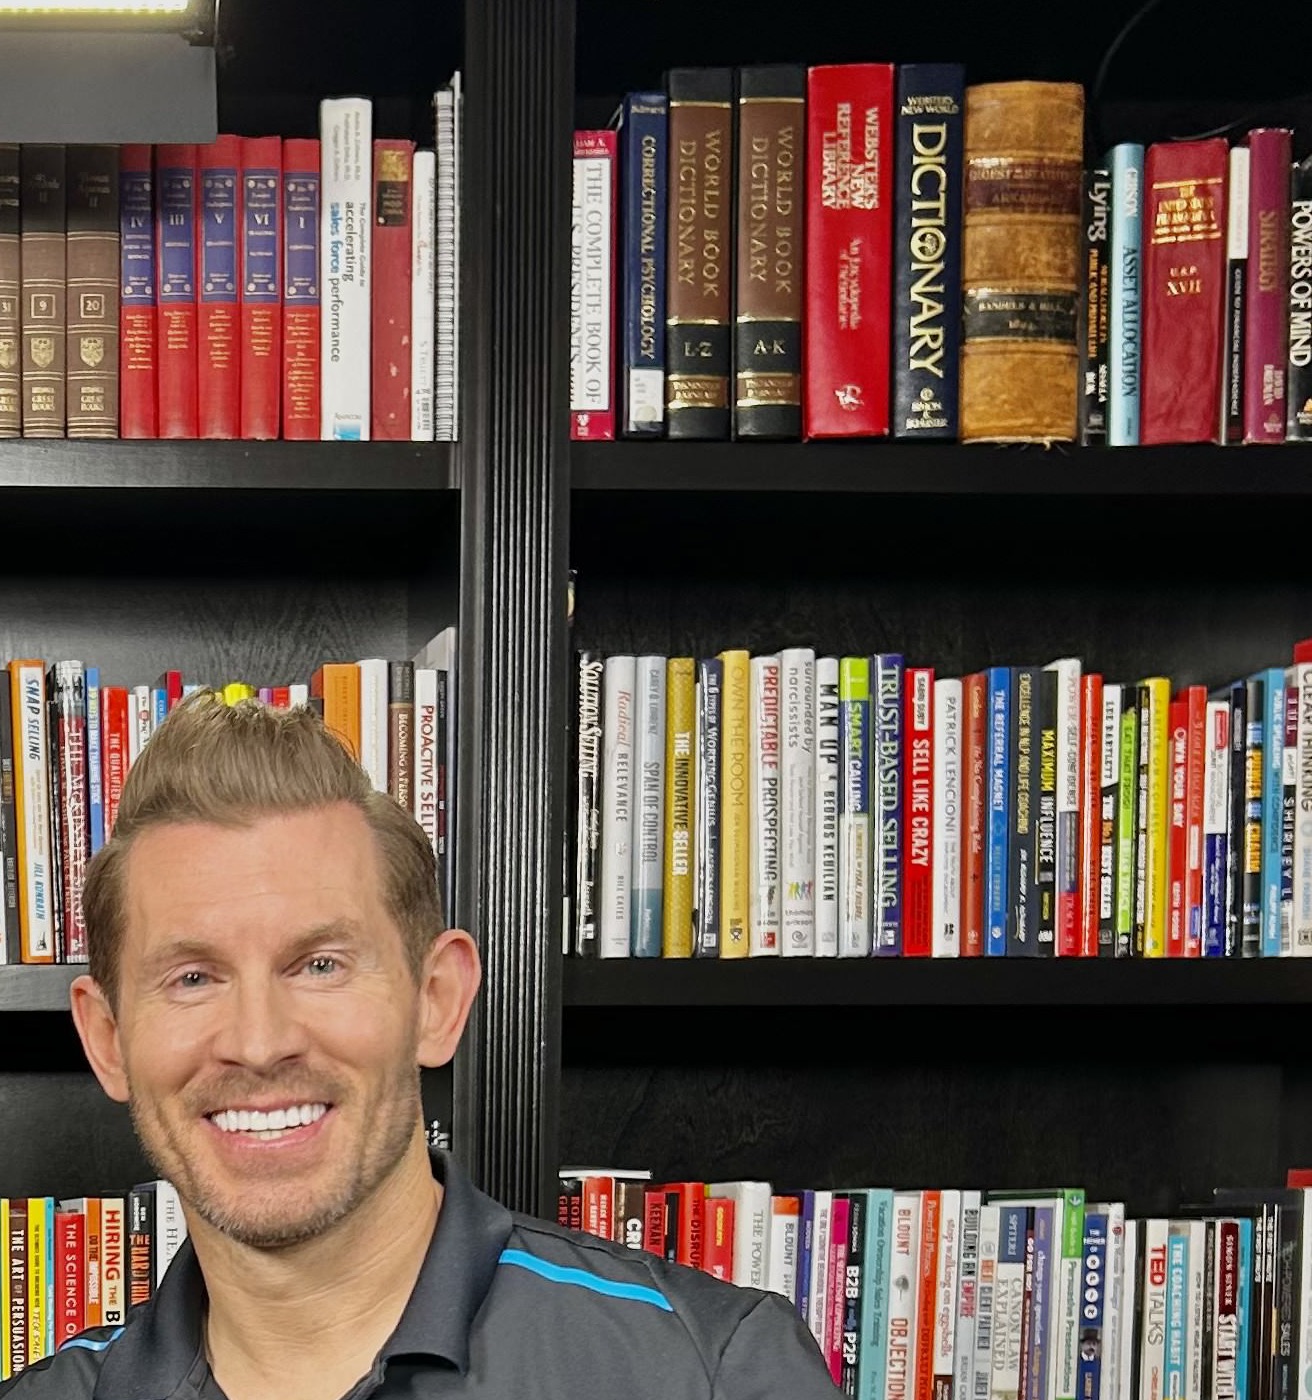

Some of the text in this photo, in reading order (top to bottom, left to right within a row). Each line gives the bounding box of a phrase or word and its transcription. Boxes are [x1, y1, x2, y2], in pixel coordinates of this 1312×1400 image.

[678, 130, 722, 296] WORLD BOOK DICTIONARY
[750, 125, 793, 293] WORLD BOOK DICTIONARY
[909, 122, 948, 378] DICTIONARY
[420, 705, 435, 786] PROACTIVE
[945, 697, 956, 754] PATRICK
[912, 740, 928, 867] SELL LIKE CRAZY
[105, 1210, 121, 1280] HIRING
[847, 1265, 859, 1298] B2B
[1150, 1244, 1166, 1284] TED
[11, 1230, 27, 1373] THE ART PERSUASION
